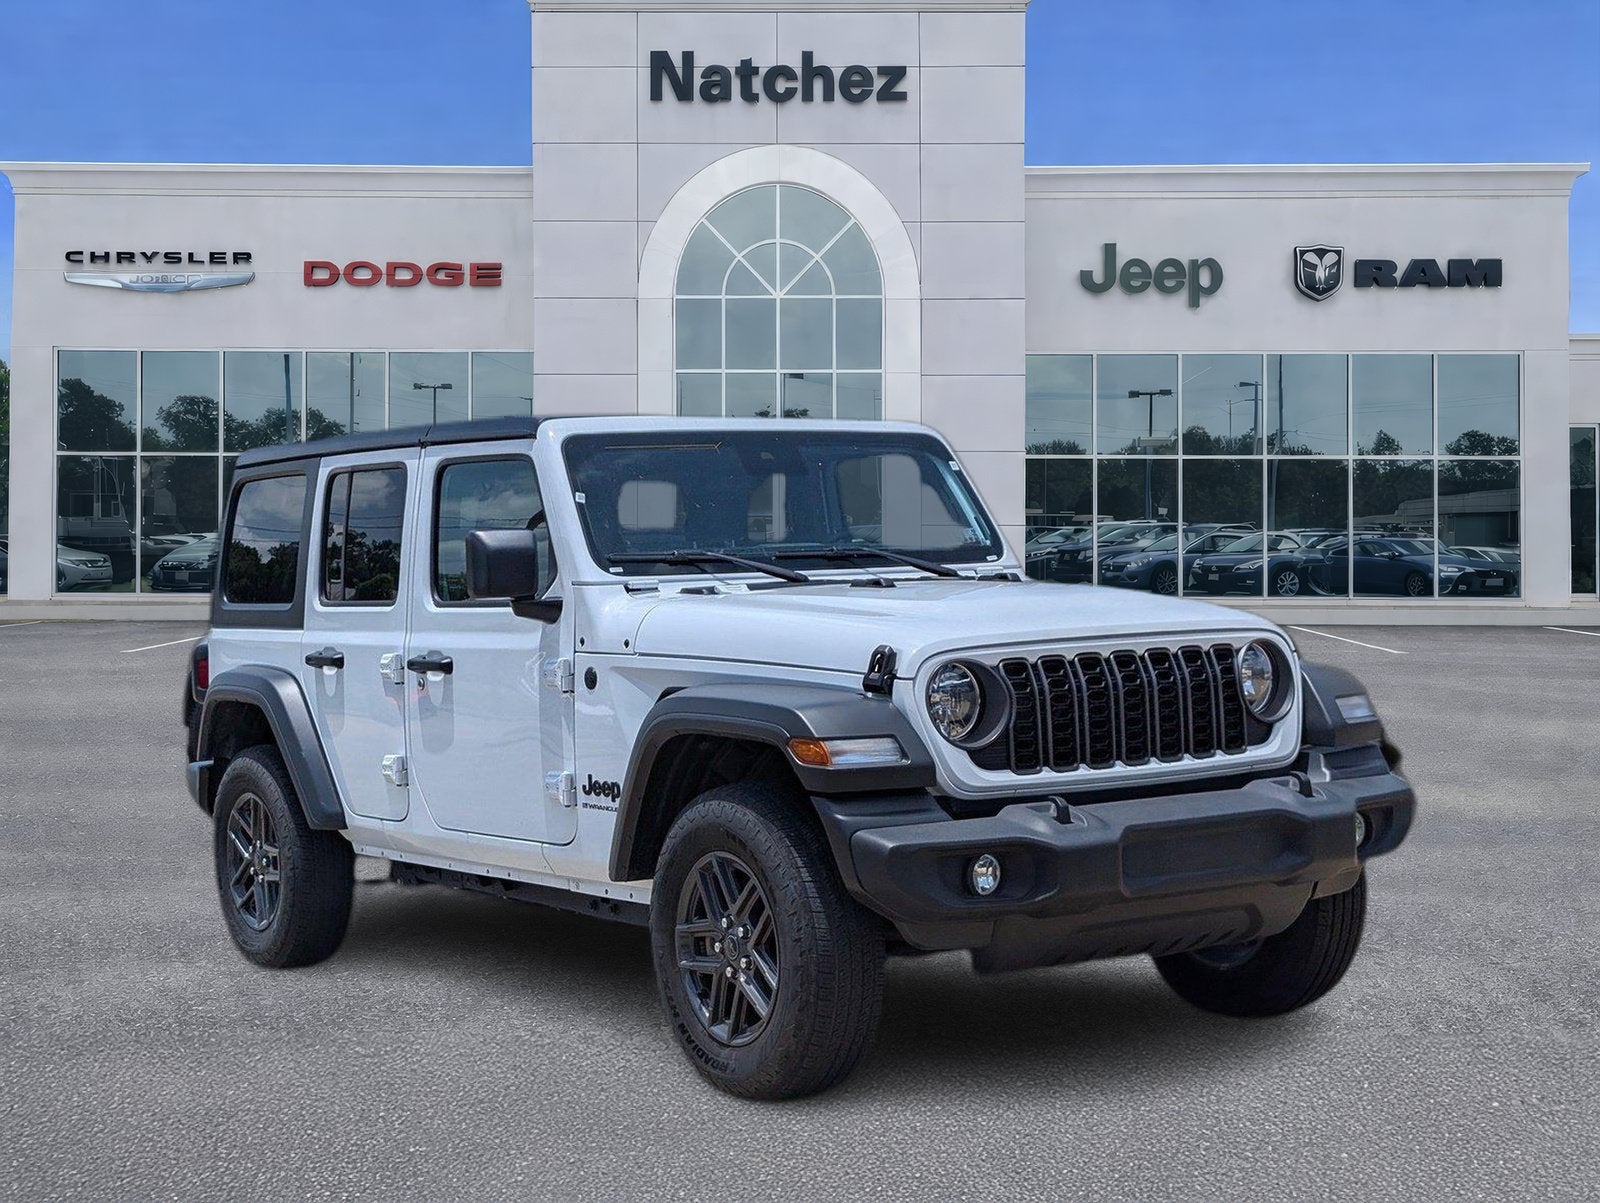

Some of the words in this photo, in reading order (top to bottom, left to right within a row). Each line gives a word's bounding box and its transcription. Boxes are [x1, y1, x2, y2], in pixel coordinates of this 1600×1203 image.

[649, 50, 908, 103] Natchez
[65, 250, 252, 265] CHRYSLER
[303, 260, 502, 287] DODGE
[1079, 242, 1223, 308] Jeep
[1353, 258, 1502, 288] RAM
[582, 773, 621, 802] Jeep
